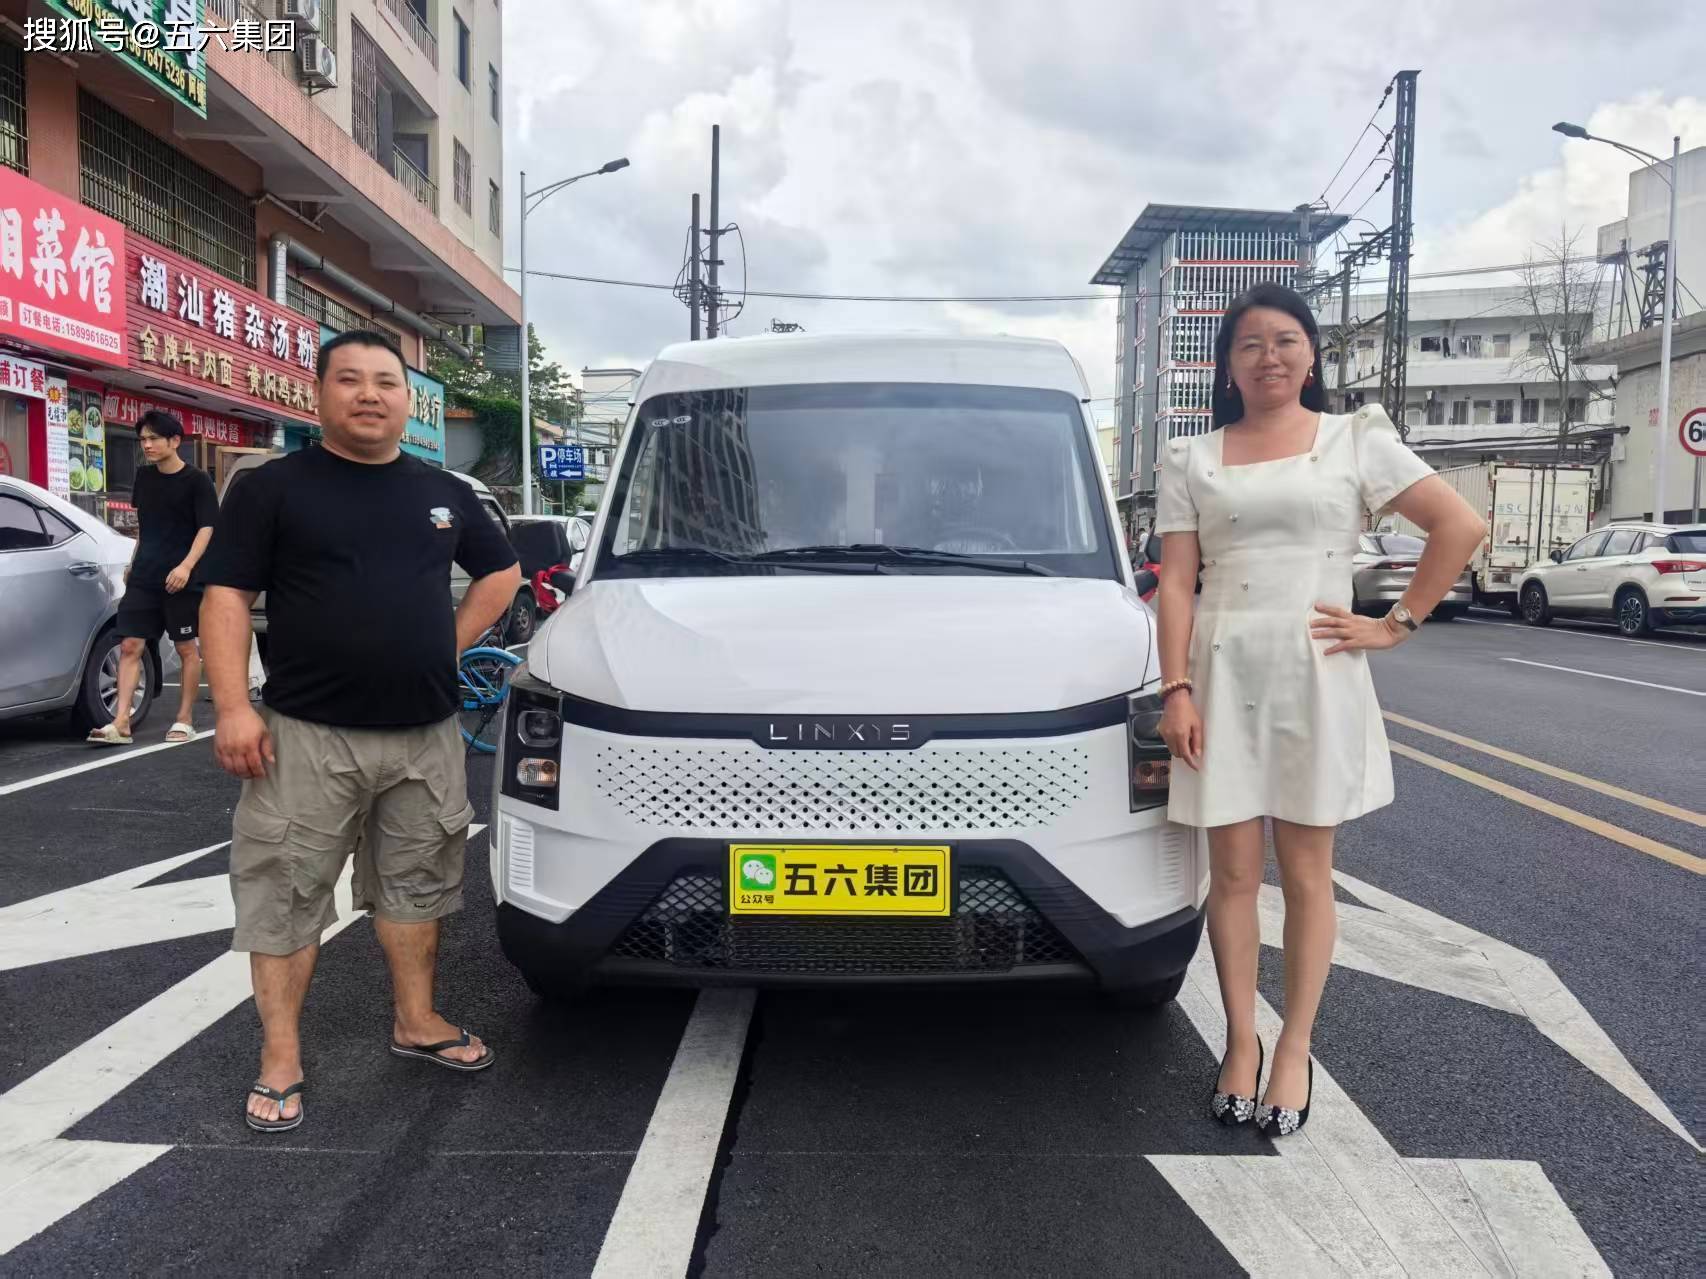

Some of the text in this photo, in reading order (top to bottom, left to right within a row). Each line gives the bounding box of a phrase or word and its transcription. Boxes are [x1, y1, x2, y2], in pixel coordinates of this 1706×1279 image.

[140, 252, 313, 369] 潮汕猪杂汤粉
[139, 324, 235, 387] 金牌牛肉面
[541, 447, 557, 469] P
[783, 863, 939, 897] 五六集团
[740, 894, 775, 905] 公众号
